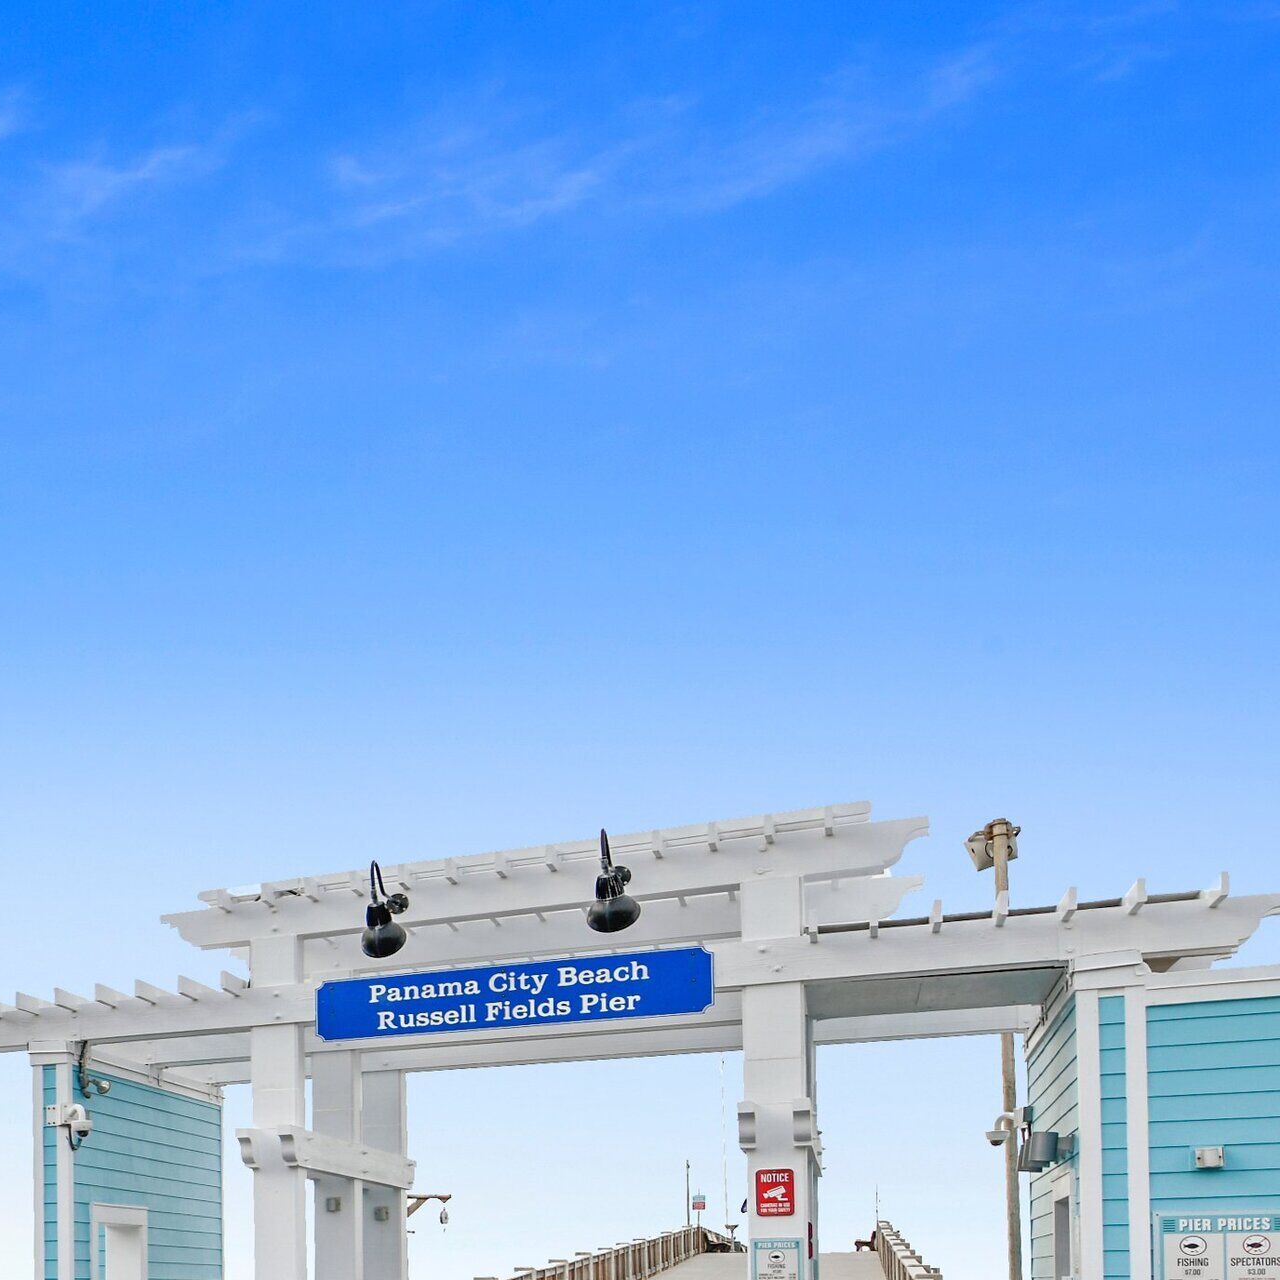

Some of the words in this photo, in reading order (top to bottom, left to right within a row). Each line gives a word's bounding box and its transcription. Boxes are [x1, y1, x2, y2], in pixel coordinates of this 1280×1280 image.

[368, 981, 481, 1004] Panama
[488, 969, 550, 994] City
[556, 961, 650, 987] Beach
[377, 1001, 476, 1030] Russell
[484, 997, 571, 1022] Fields
[579, 993, 641, 1015] Pier
[761, 1173, 790, 1183] NOTICE
[1179, 1218, 1212, 1232] PIER
[1217, 1217, 1271, 1232] PRICES
[1177, 1258, 1209, 1267] FISHING
[1230, 1257, 1280, 1267] SPECTATORS
